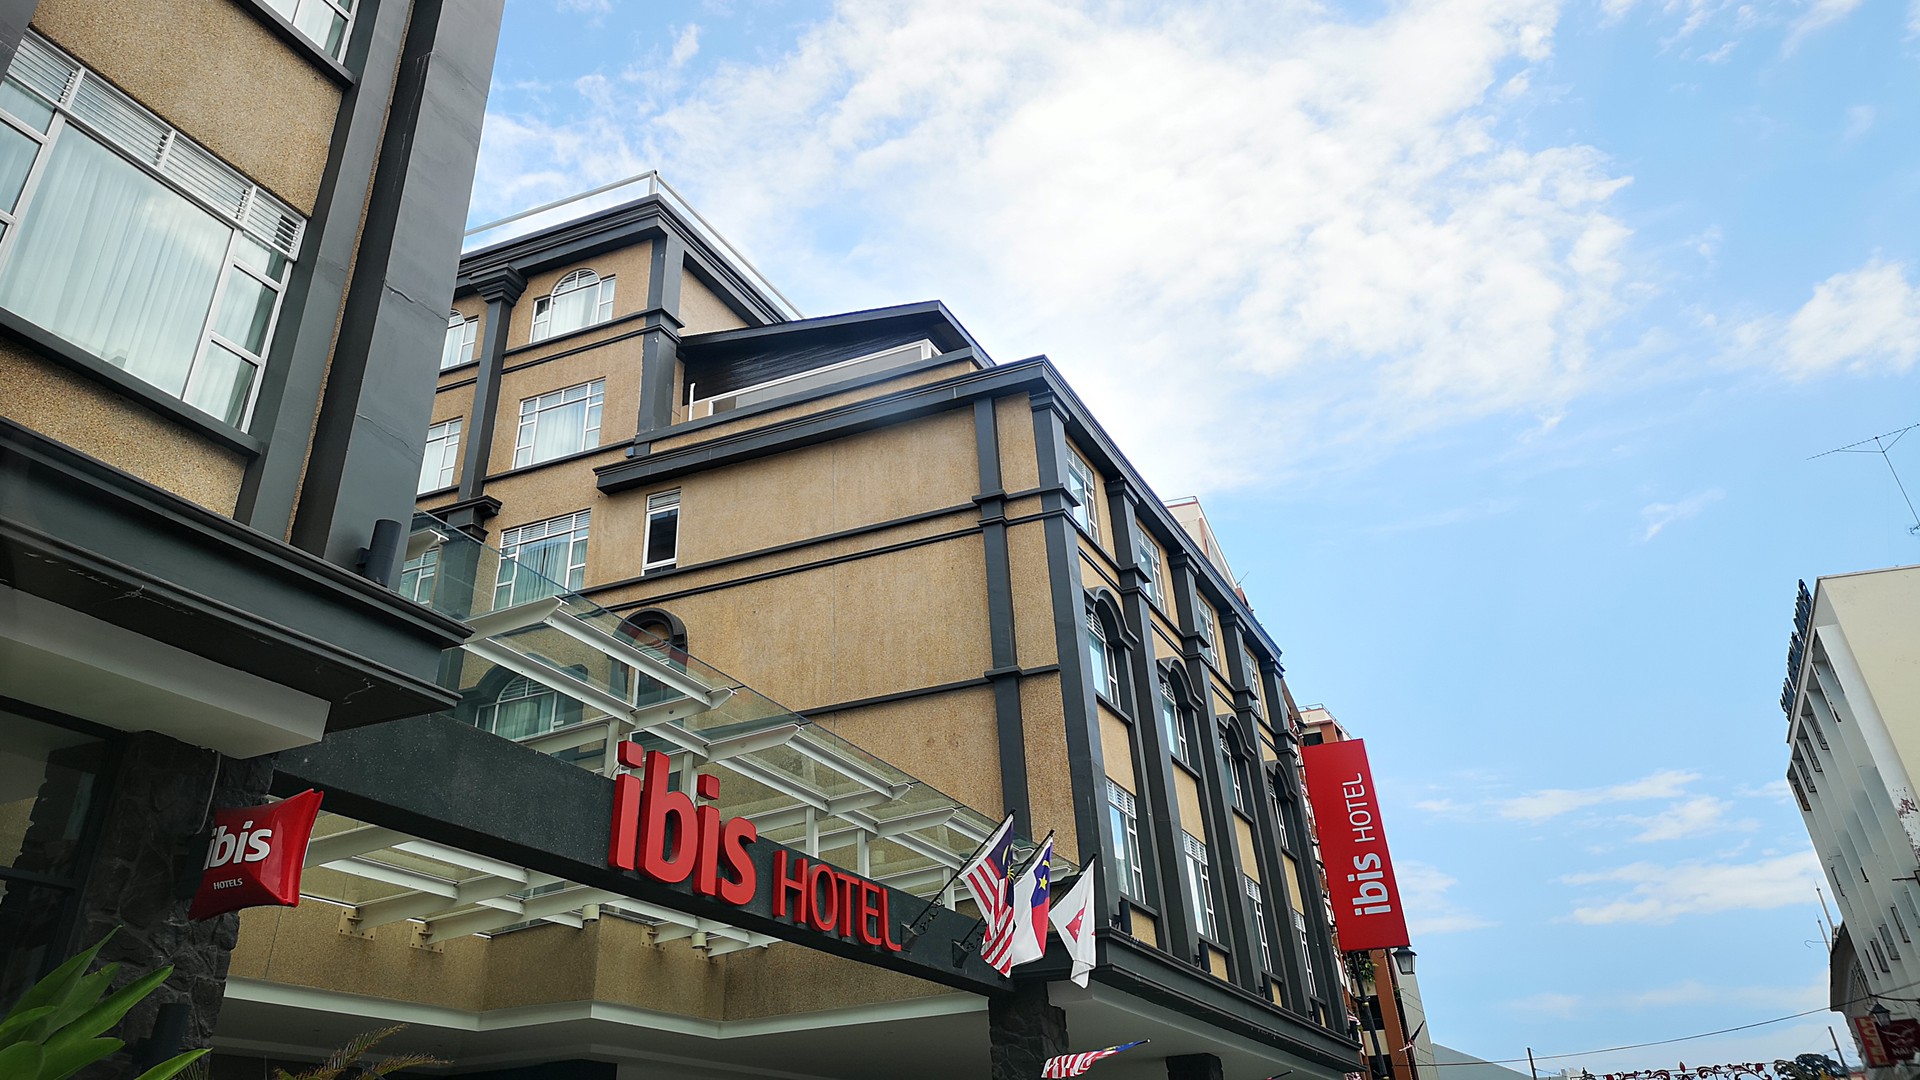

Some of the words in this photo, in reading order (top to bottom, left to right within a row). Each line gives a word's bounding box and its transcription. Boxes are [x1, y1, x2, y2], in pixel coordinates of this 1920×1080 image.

[1342, 772, 1376, 843] HOTEL
[203, 820, 272, 872] ibis
[608, 740, 758, 906] ibis
[772, 850, 902, 952] HOTEL
[213, 877, 243, 890] HOTELS
[1347, 852, 1392, 916] ibis
